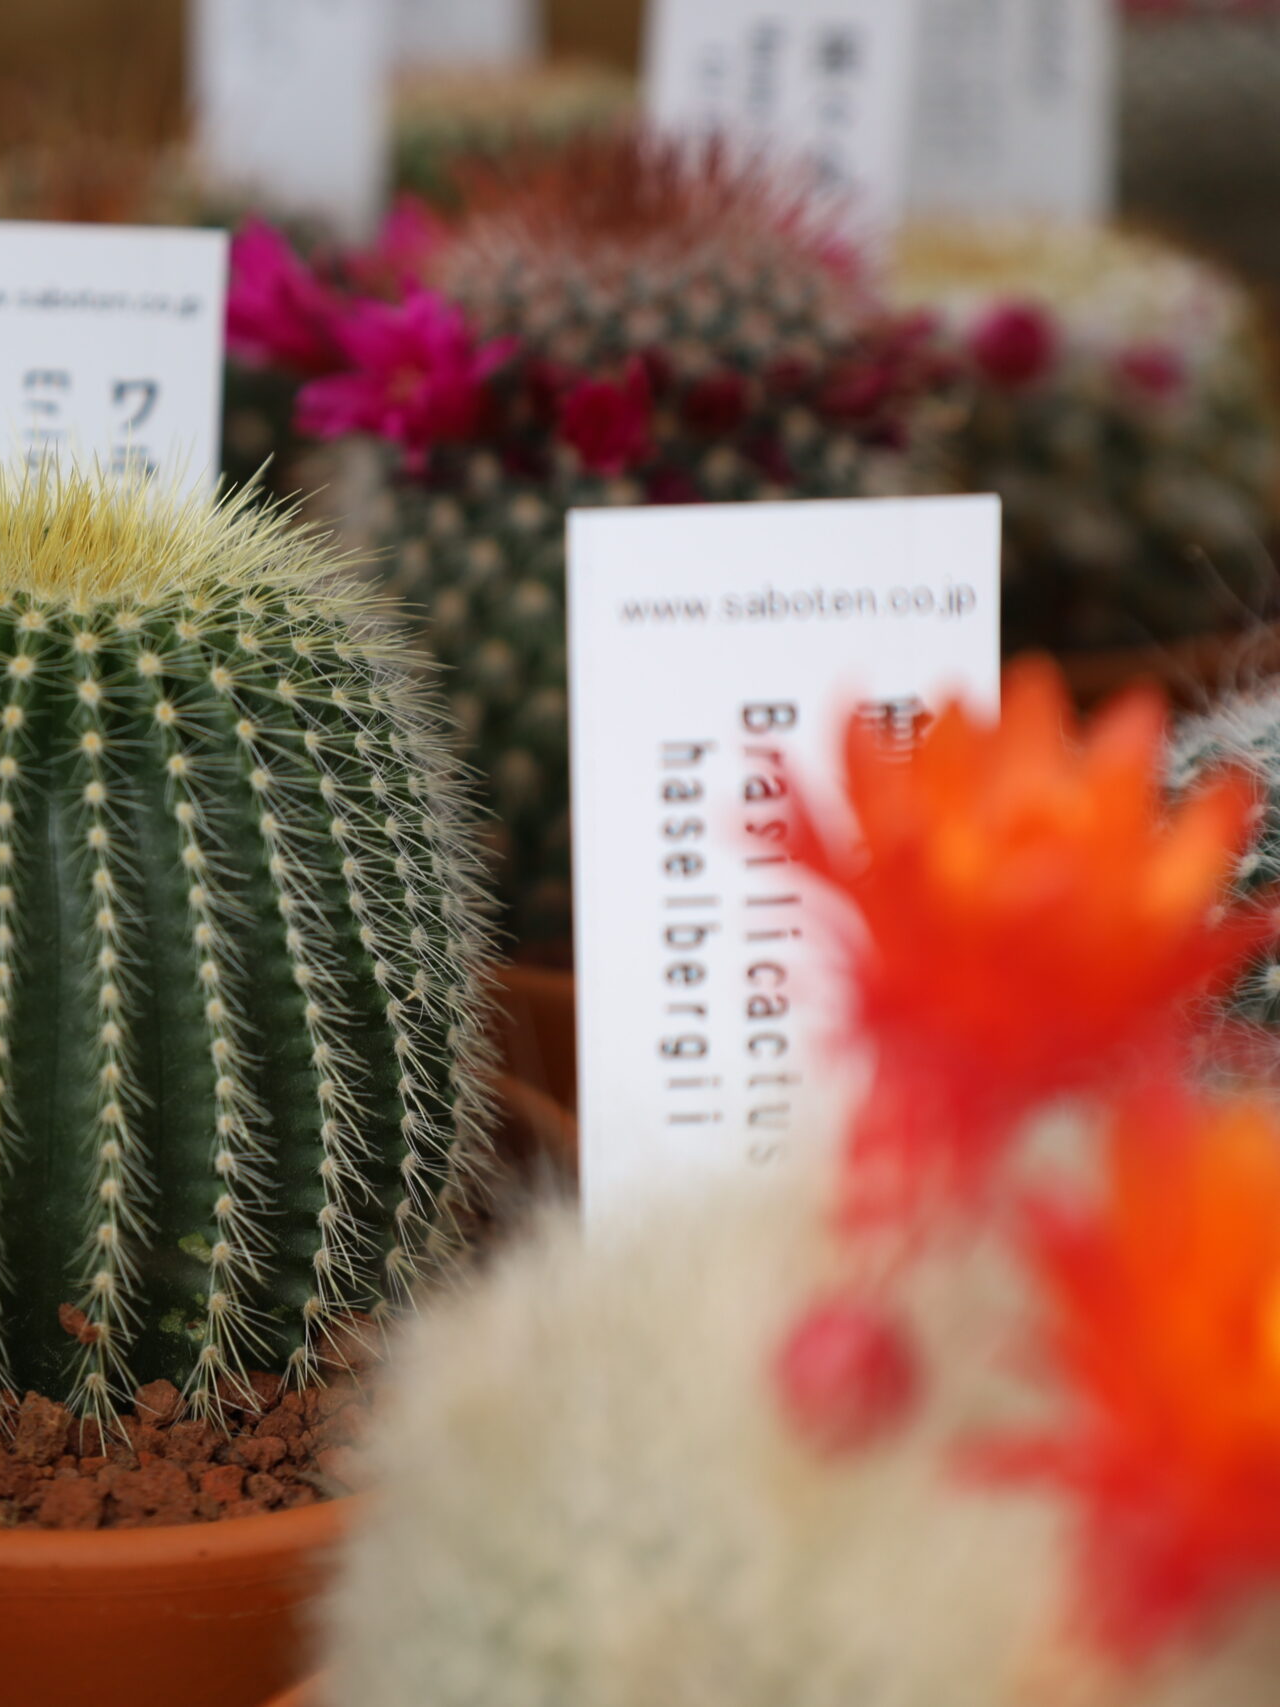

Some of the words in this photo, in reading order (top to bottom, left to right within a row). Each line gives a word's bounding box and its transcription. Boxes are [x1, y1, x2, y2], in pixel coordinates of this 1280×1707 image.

[619, 577, 977, 623] www.saboten.co.jp
[658, 740, 722, 1131] haselbergii
[742, 701, 803, 1165] Brasilicactus
